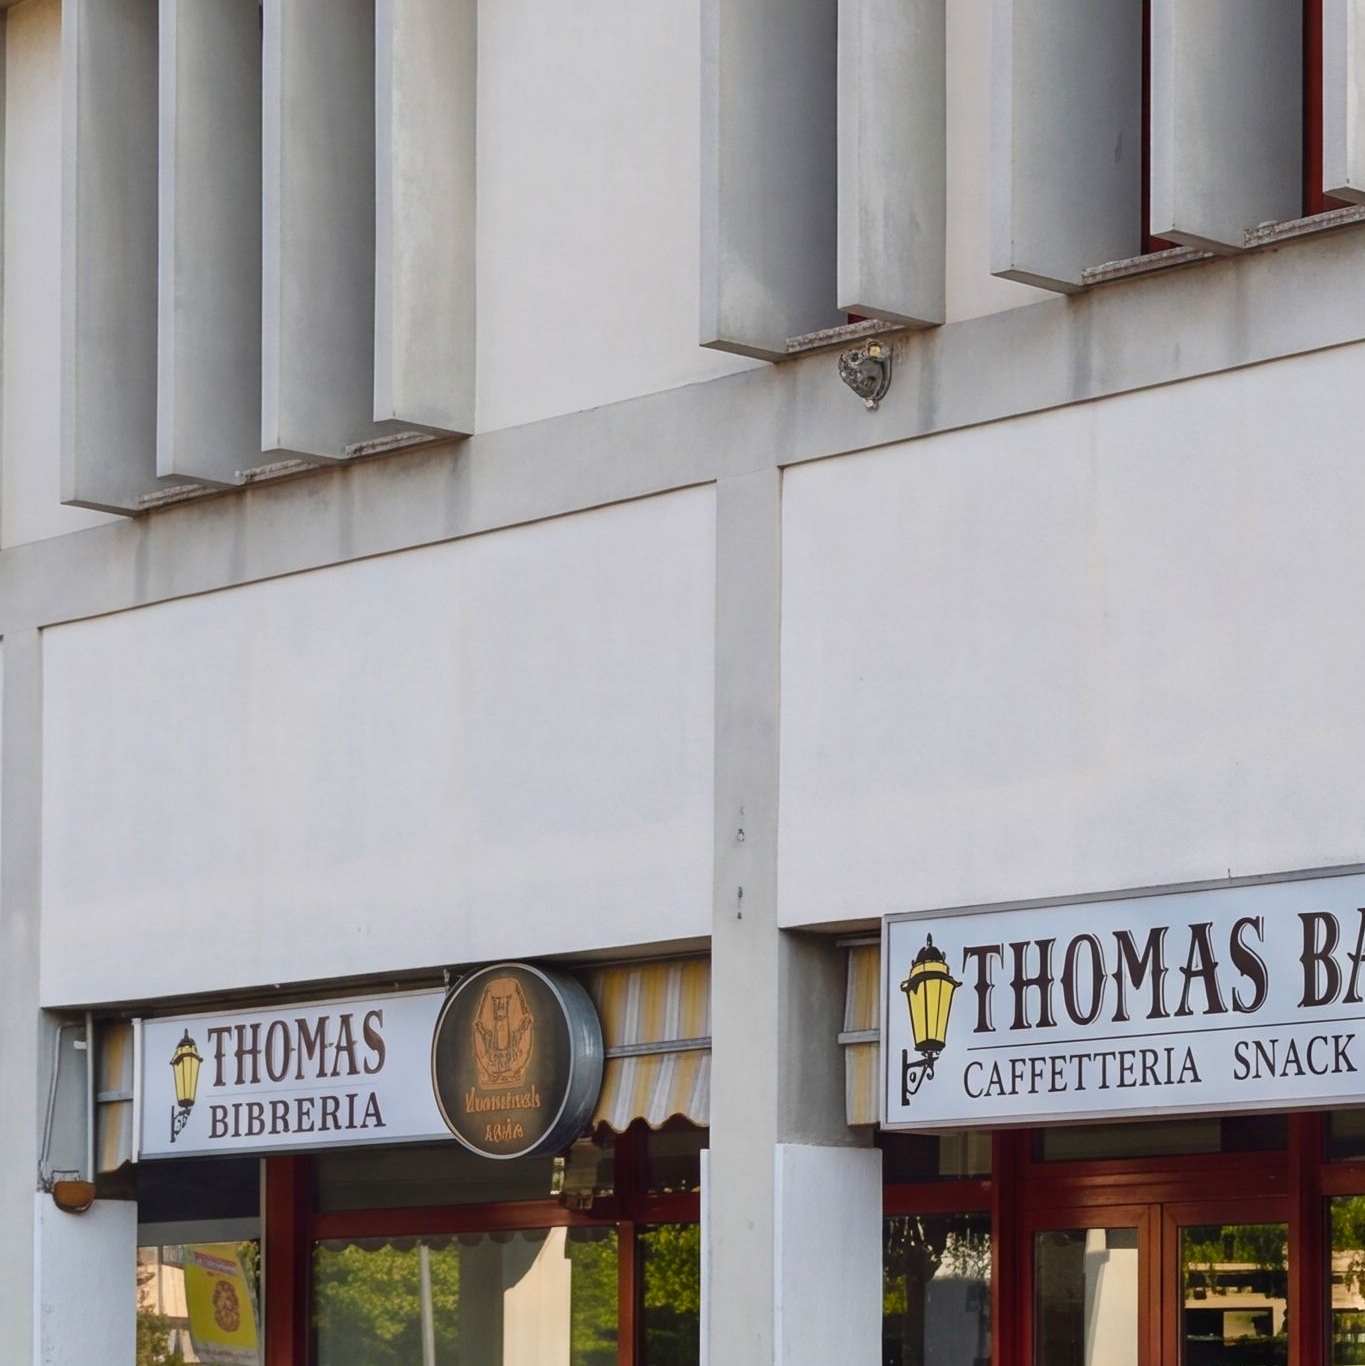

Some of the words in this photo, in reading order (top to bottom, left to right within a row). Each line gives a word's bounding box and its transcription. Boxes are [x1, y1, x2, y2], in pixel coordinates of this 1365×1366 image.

[962, 915, 1269, 1033] THOMAS
[207, 1009, 386, 1087] THOMAS
[963, 1046, 1202, 1099] CAFFETTERIA
[1233, 1034, 1358, 1082] SNACK
[208, 1091, 387, 1139] BIBRERIA
